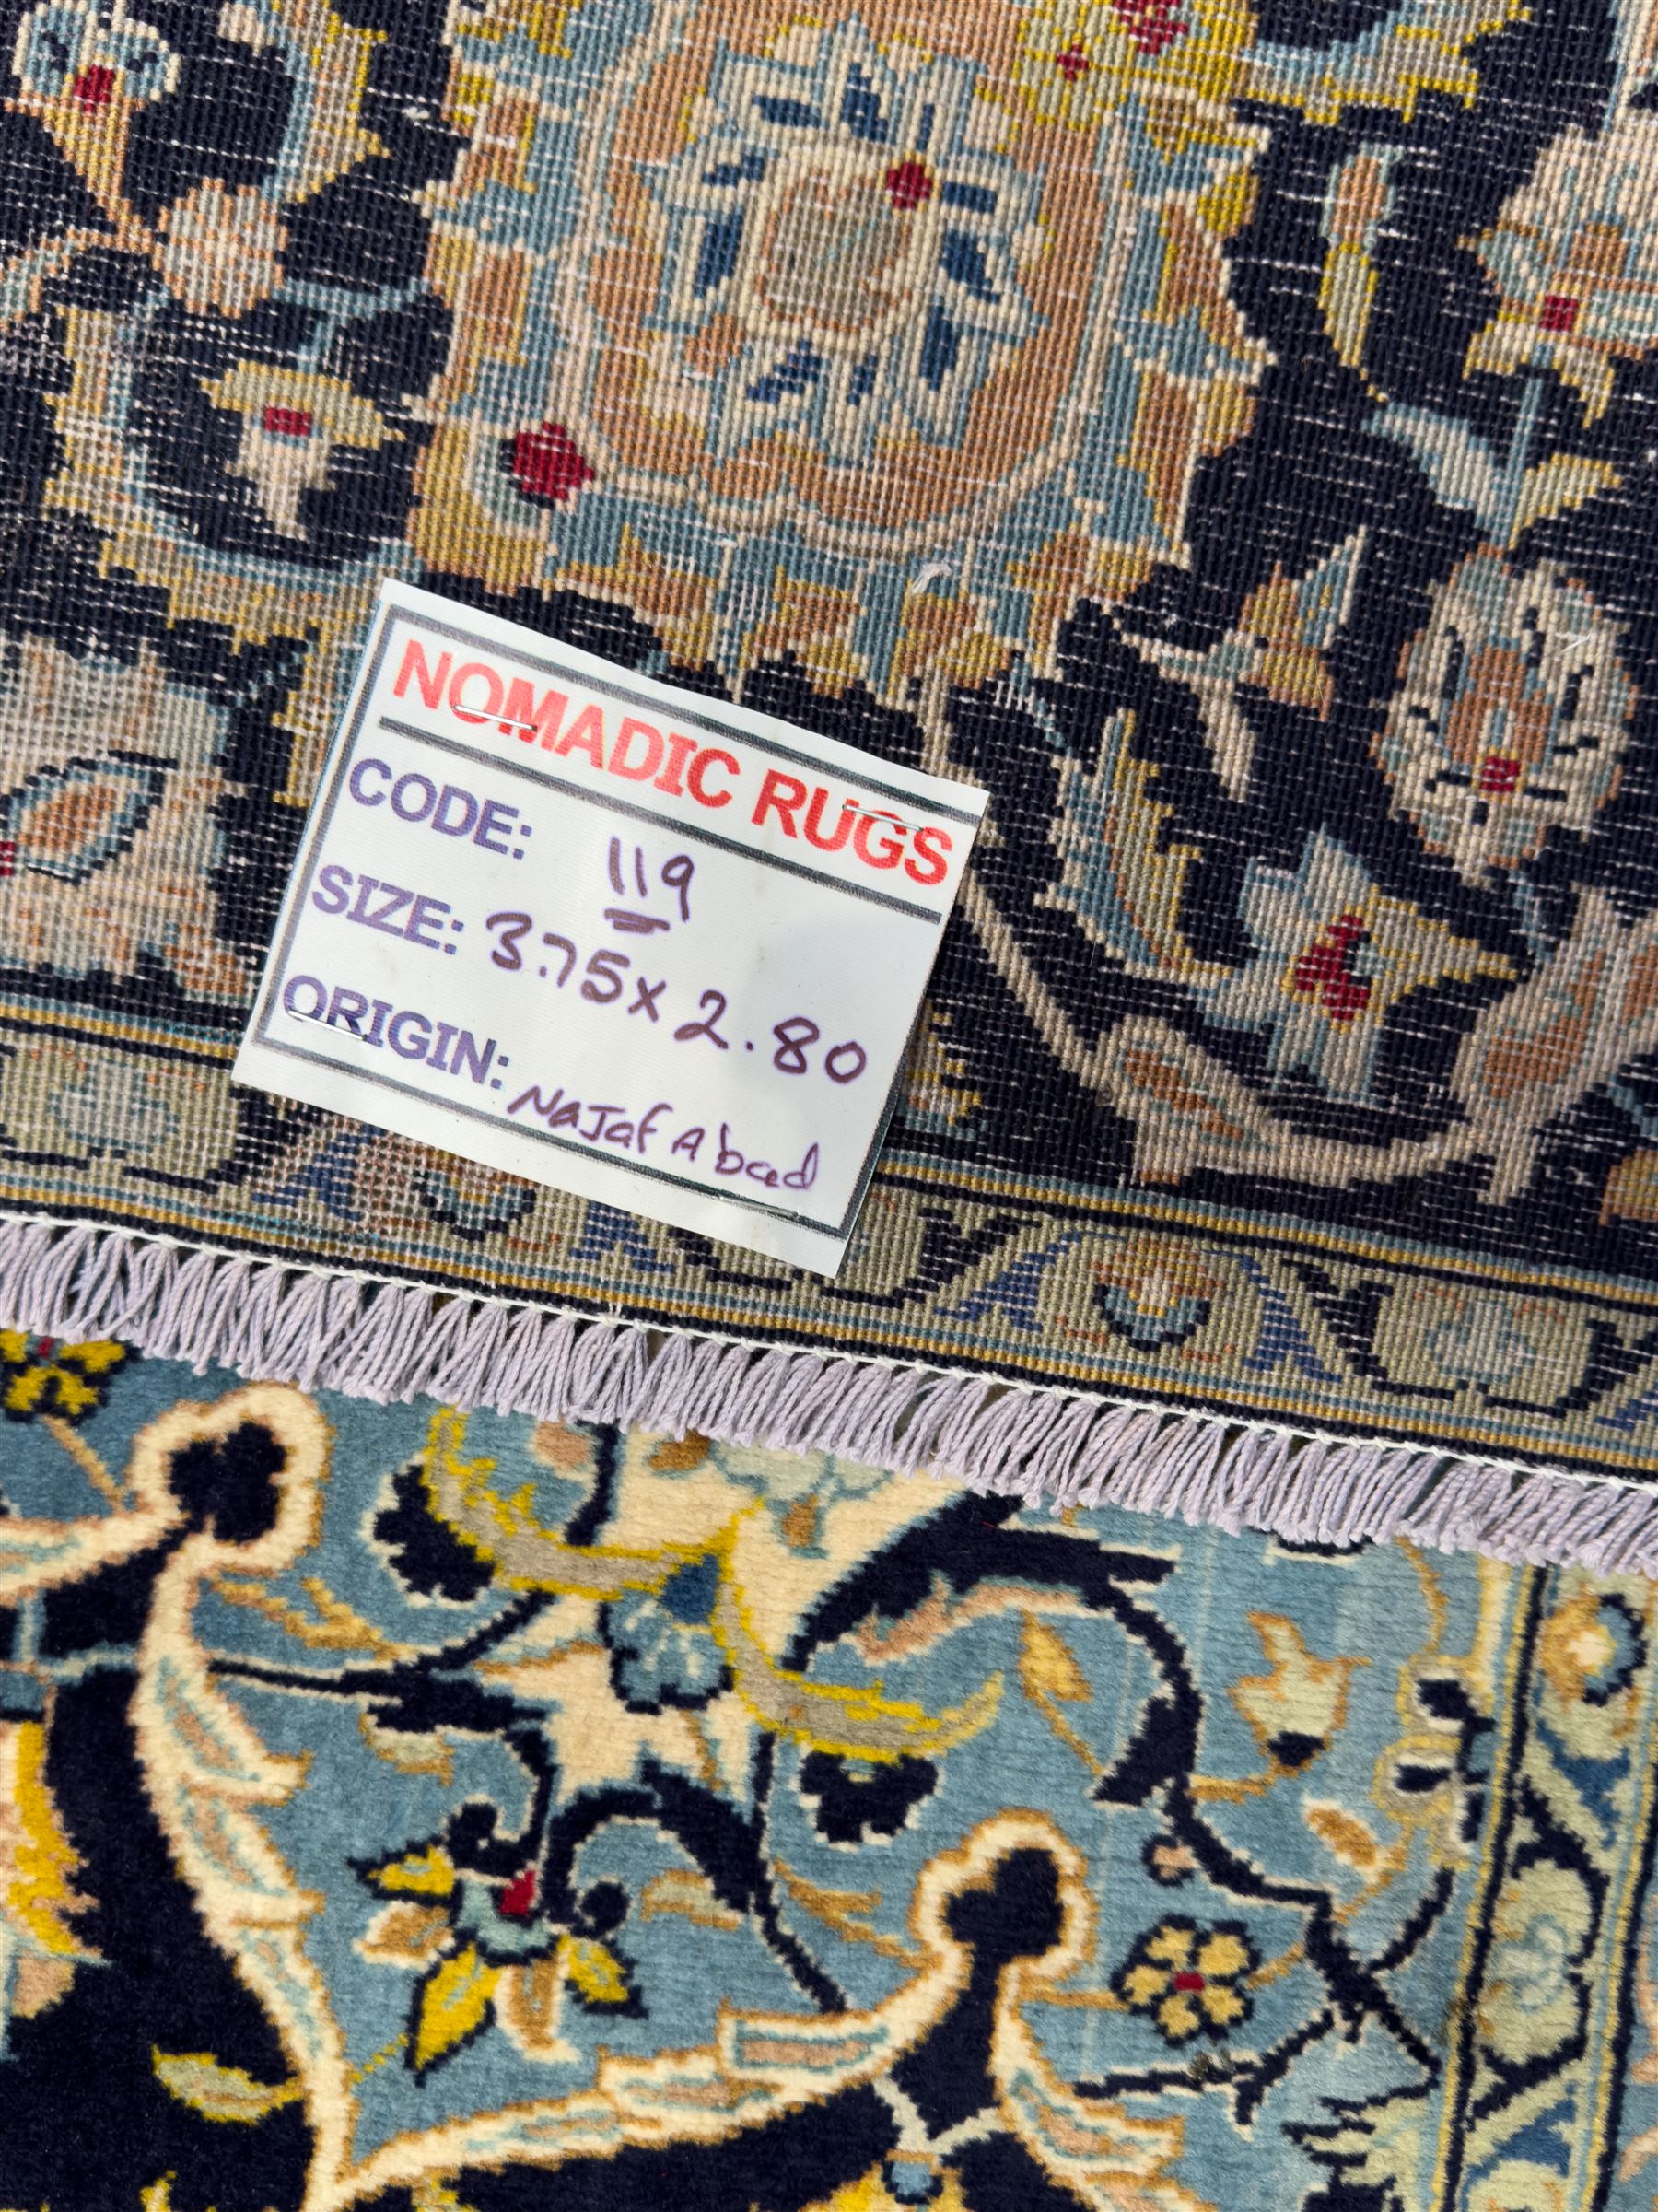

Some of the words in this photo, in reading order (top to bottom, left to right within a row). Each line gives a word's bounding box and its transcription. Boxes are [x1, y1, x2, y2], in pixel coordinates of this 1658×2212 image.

[349, 759, 531, 860] CODE:
[607, 837, 695, 922] 119
[393, 640, 740, 809] NOMADIC
[753, 769, 952, 885] RUGS
[285, 975, 509, 1089] ORIGIN:
[312, 865, 463, 954] SIZE:
[676, 991, 867, 1084] 2.80
